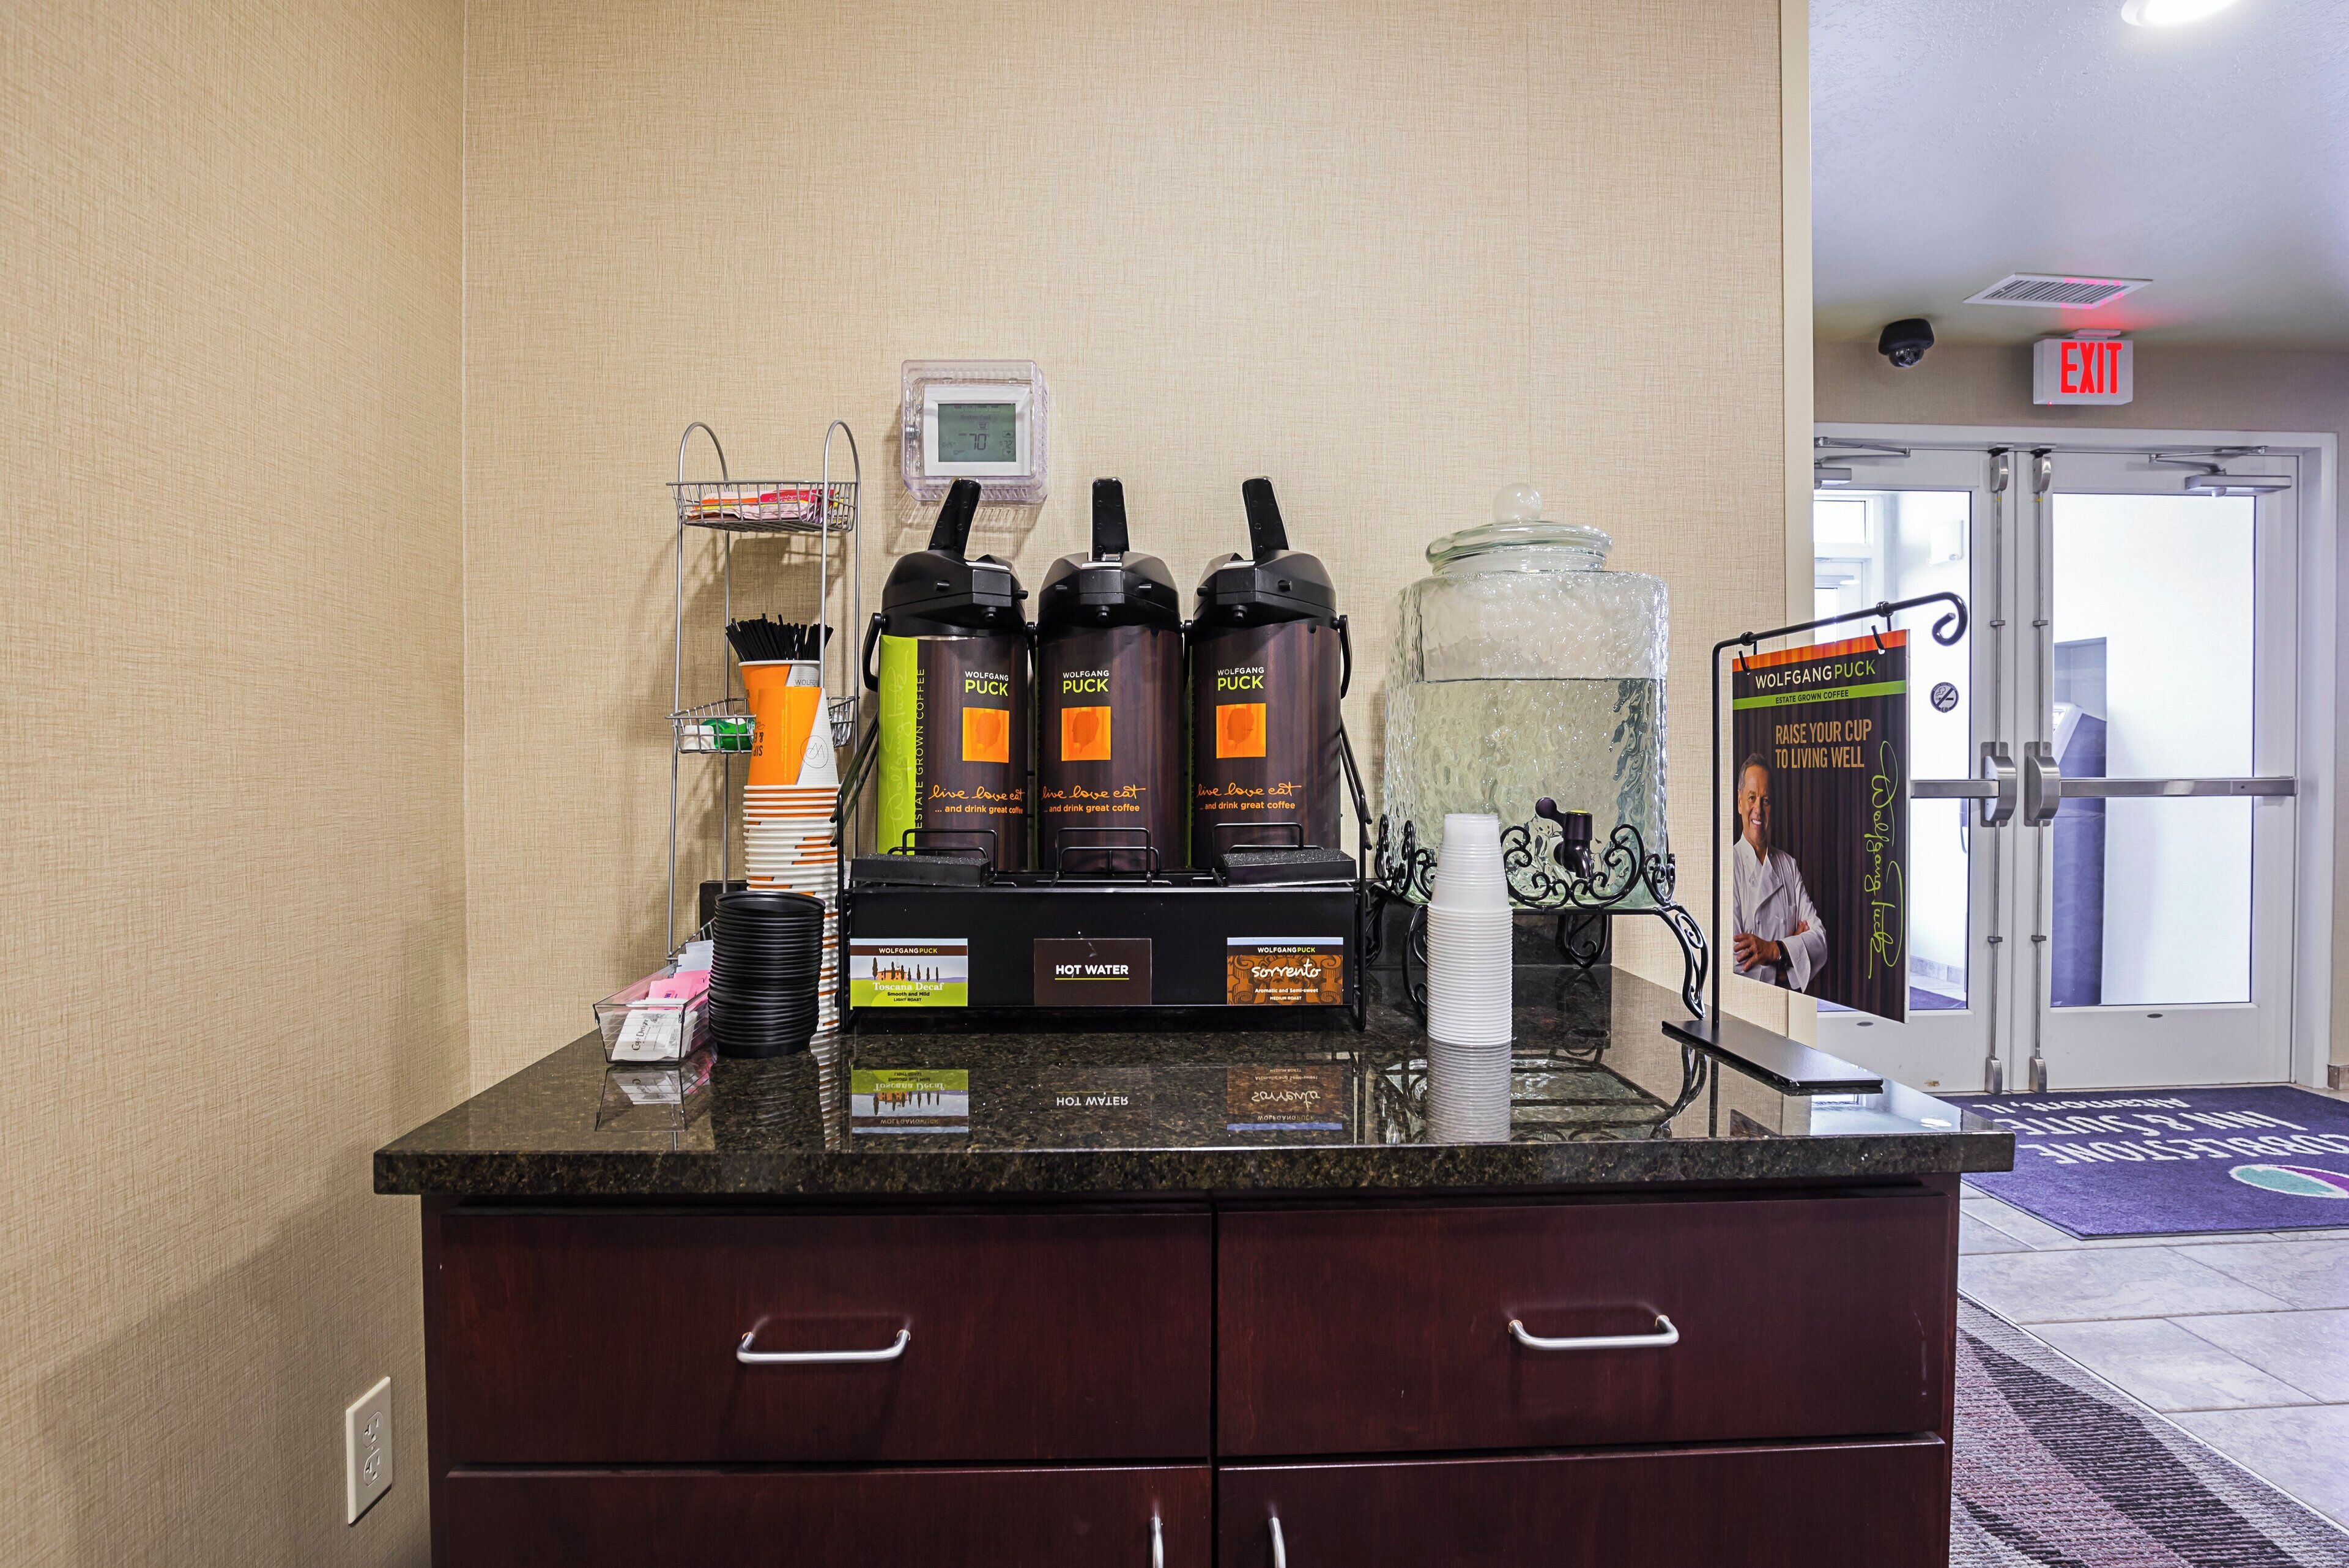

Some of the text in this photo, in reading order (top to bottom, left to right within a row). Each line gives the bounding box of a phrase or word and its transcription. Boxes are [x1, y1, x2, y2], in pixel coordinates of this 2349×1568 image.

[2061, 342, 2123, 394] EXIT
[965, 671, 1009, 682] WOLFGANG
[1063, 670, 1109, 679] WOLFGANG
[1217, 667, 1264, 676] WOLFGANG
[1756, 660, 1876, 689] WOLFGANG PUCK
[965, 679, 1008, 696] PUCK
[1063, 678, 1108, 693] PUCK
[1218, 675, 1264, 691] PUCK
[1775, 689, 1849, 704] ESTATE GROWN COFFEE
[1776, 719, 1872, 745] RAISE YOUR CUP
[915, 669, 924, 828] ESTATE GROWN COFFEE
[1776, 746, 1865, 768] TO LIVING WELL
[929, 785, 1025, 802] live love eat
[1041, 784, 1146, 800] live love eat
[1197, 781, 1302, 797] live love eat
[989, 806, 1008, 814] great
[1009, 806, 1023, 814] coffee
[1086, 804, 1110, 814] great
[1112, 803, 1140, 812] coffee
[1241, 801, 1264, 811] great
[1267, 800, 1296, 809] coffee
[1056, 965, 1129, 975] HOT WATER
[873, 982, 944, 991] Toscana Decaf
[1972, 1098, 2191, 1113] Altamont, IL
[2132, 1114, 2194, 1131] &
